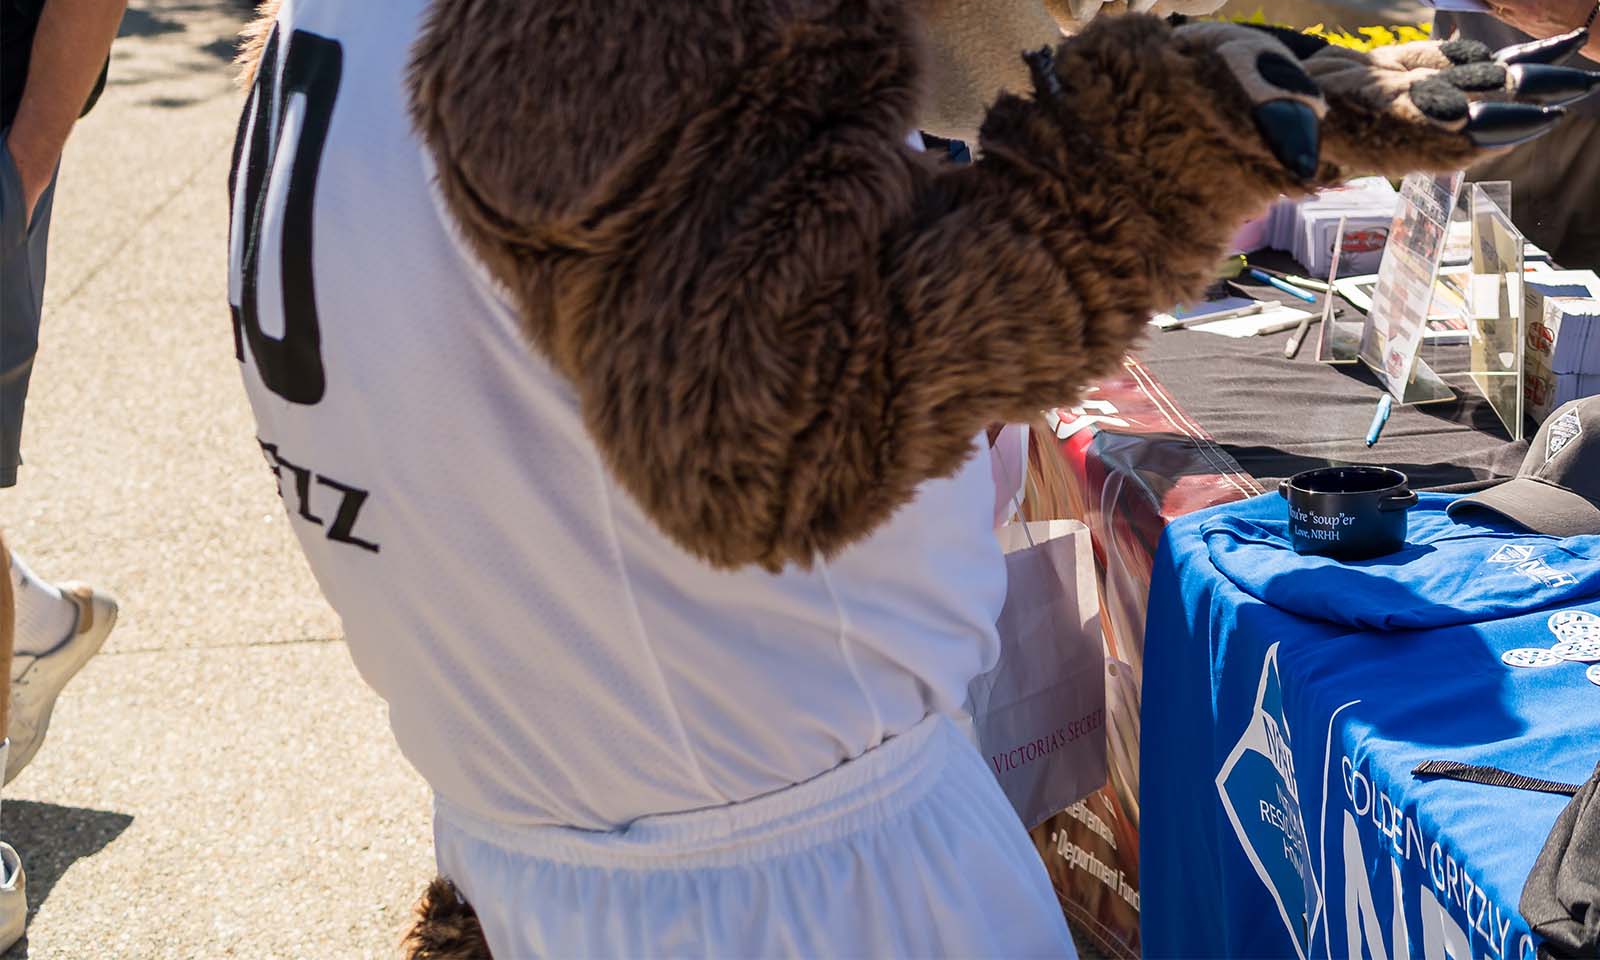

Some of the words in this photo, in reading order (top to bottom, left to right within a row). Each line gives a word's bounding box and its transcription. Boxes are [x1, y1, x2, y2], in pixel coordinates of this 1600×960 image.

[1310, 528, 1340, 541] NRHH
[992, 727, 1066, 775] VICTORIA'S
[1066, 707, 1105, 743] SECRET
[1342, 755, 1427, 869] GOLDEN
[1430, 841, 1511, 959] GRIZZLY
